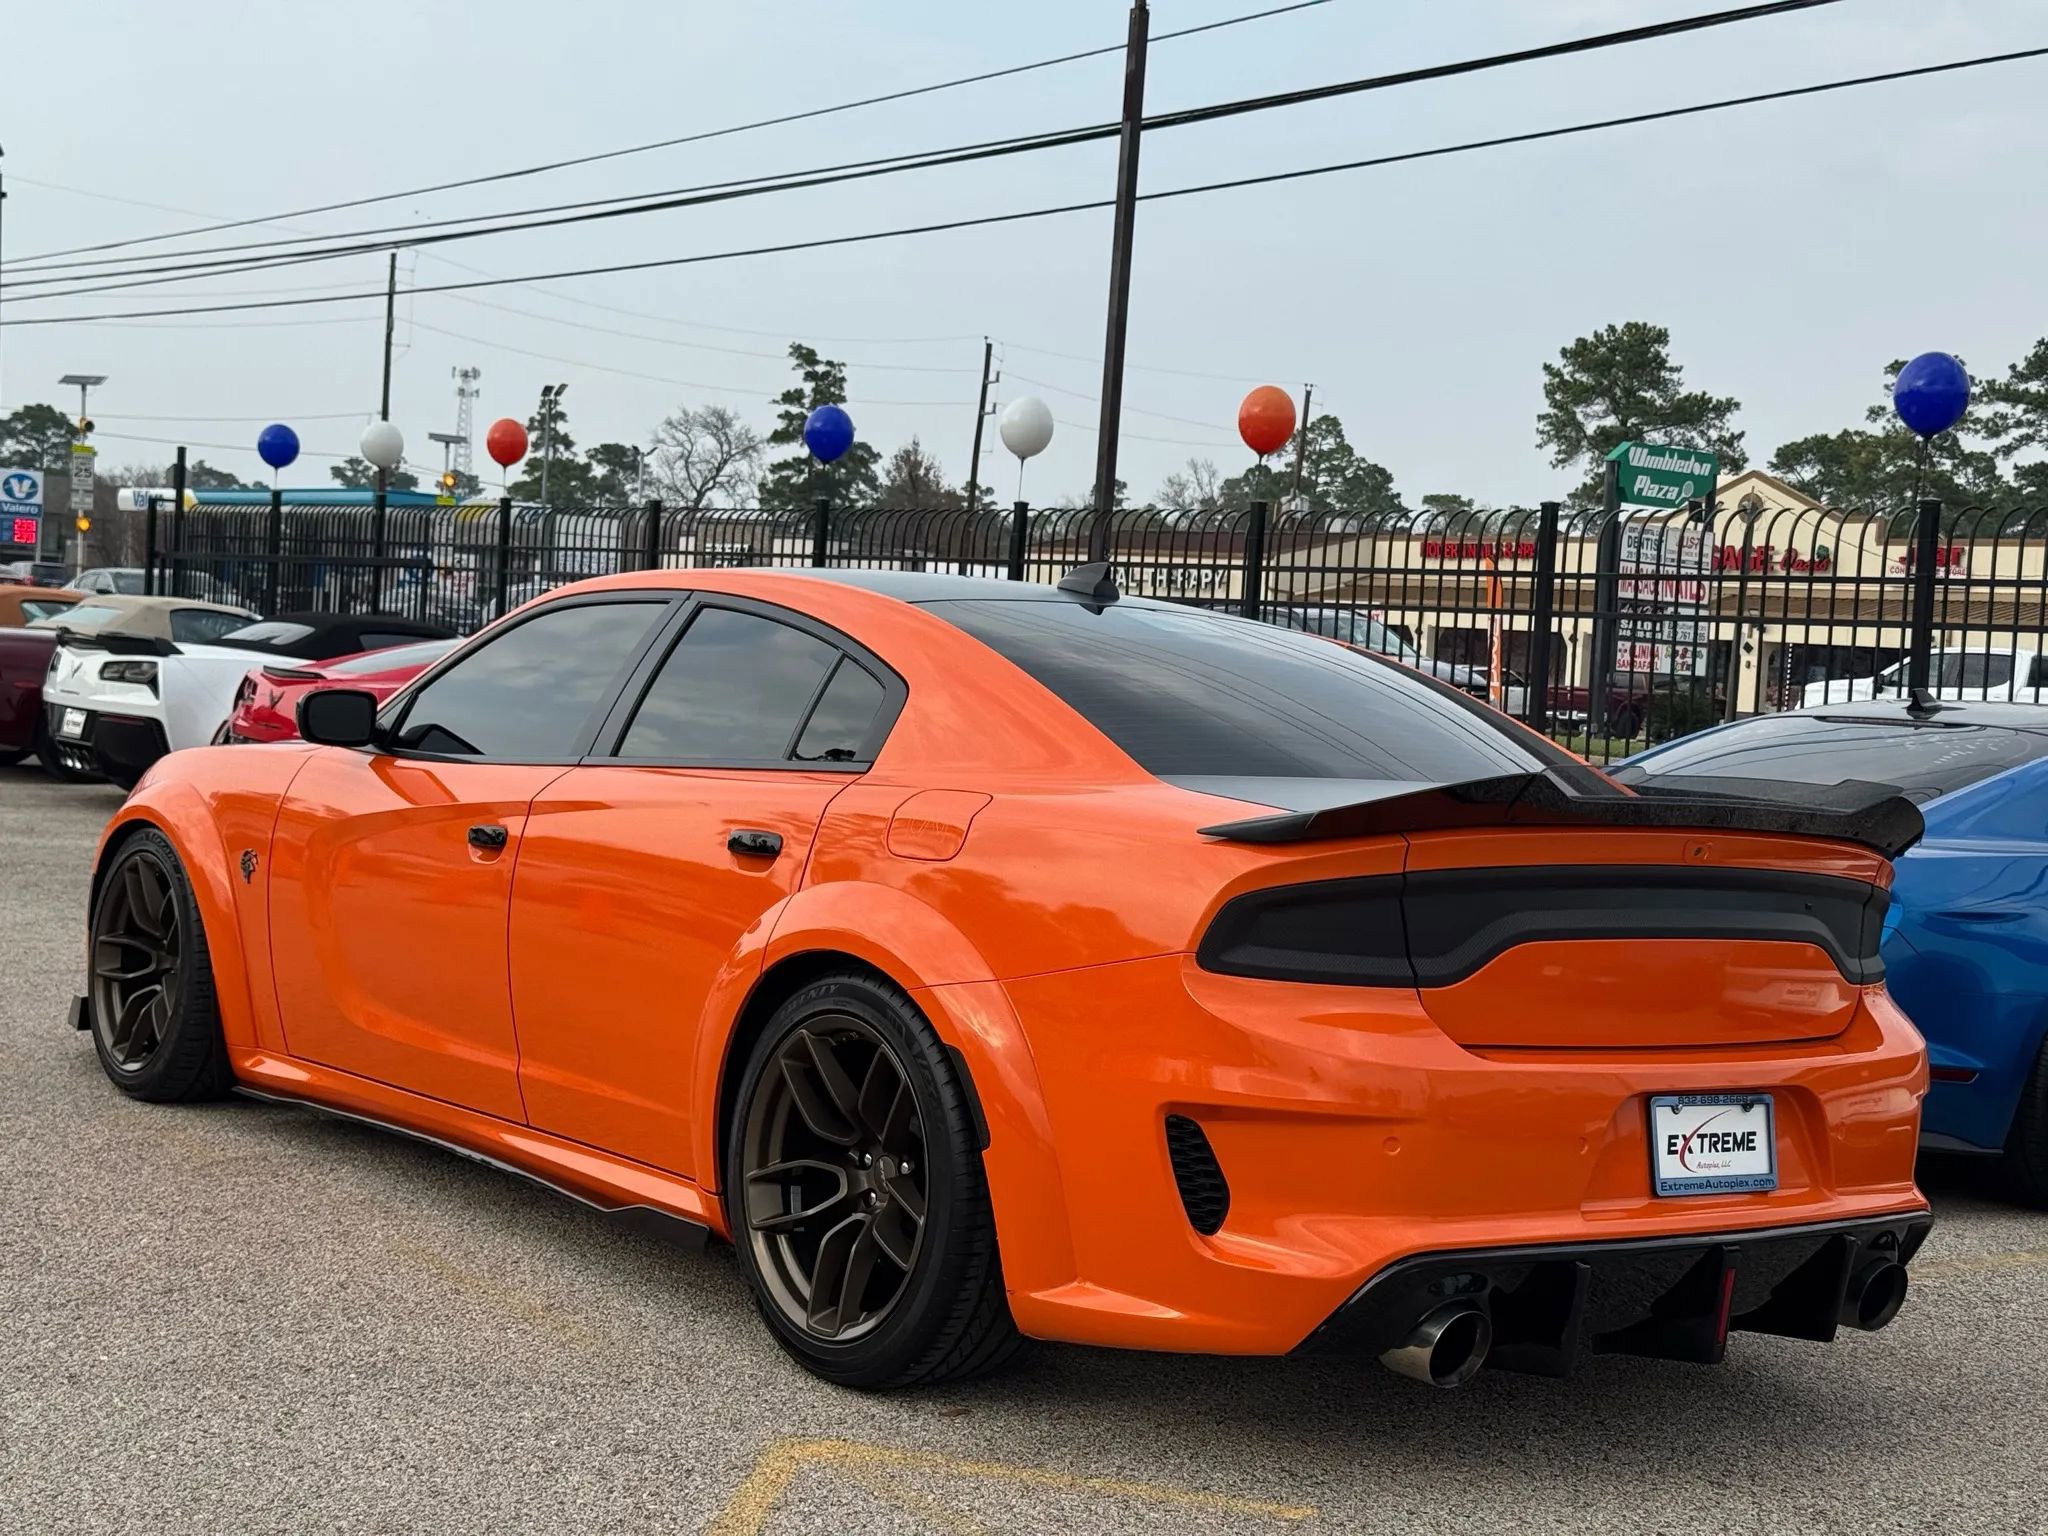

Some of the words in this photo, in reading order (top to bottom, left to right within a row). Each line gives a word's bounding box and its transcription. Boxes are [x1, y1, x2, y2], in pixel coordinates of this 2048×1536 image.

[1629, 446, 1712, 476] Wimbledon
[74, 466, 92, 479] 25
[1633, 475, 1680, 500] Plaza
[132, 490, 165, 508] Valo
[2, 503, 39, 515] Valero
[1627, 534, 1664, 552] DENTIS
[1675, 535, 1701, 550] UST
[1898, 546, 1965, 567] JST
[1146, 567, 1225, 588] THRAPY
[1630, 643, 1660, 661] LINIA
[1667, 1131, 1757, 1156] EXTREME
[1660, 1178, 1775, 1192] ExtremeAutoplex.com
